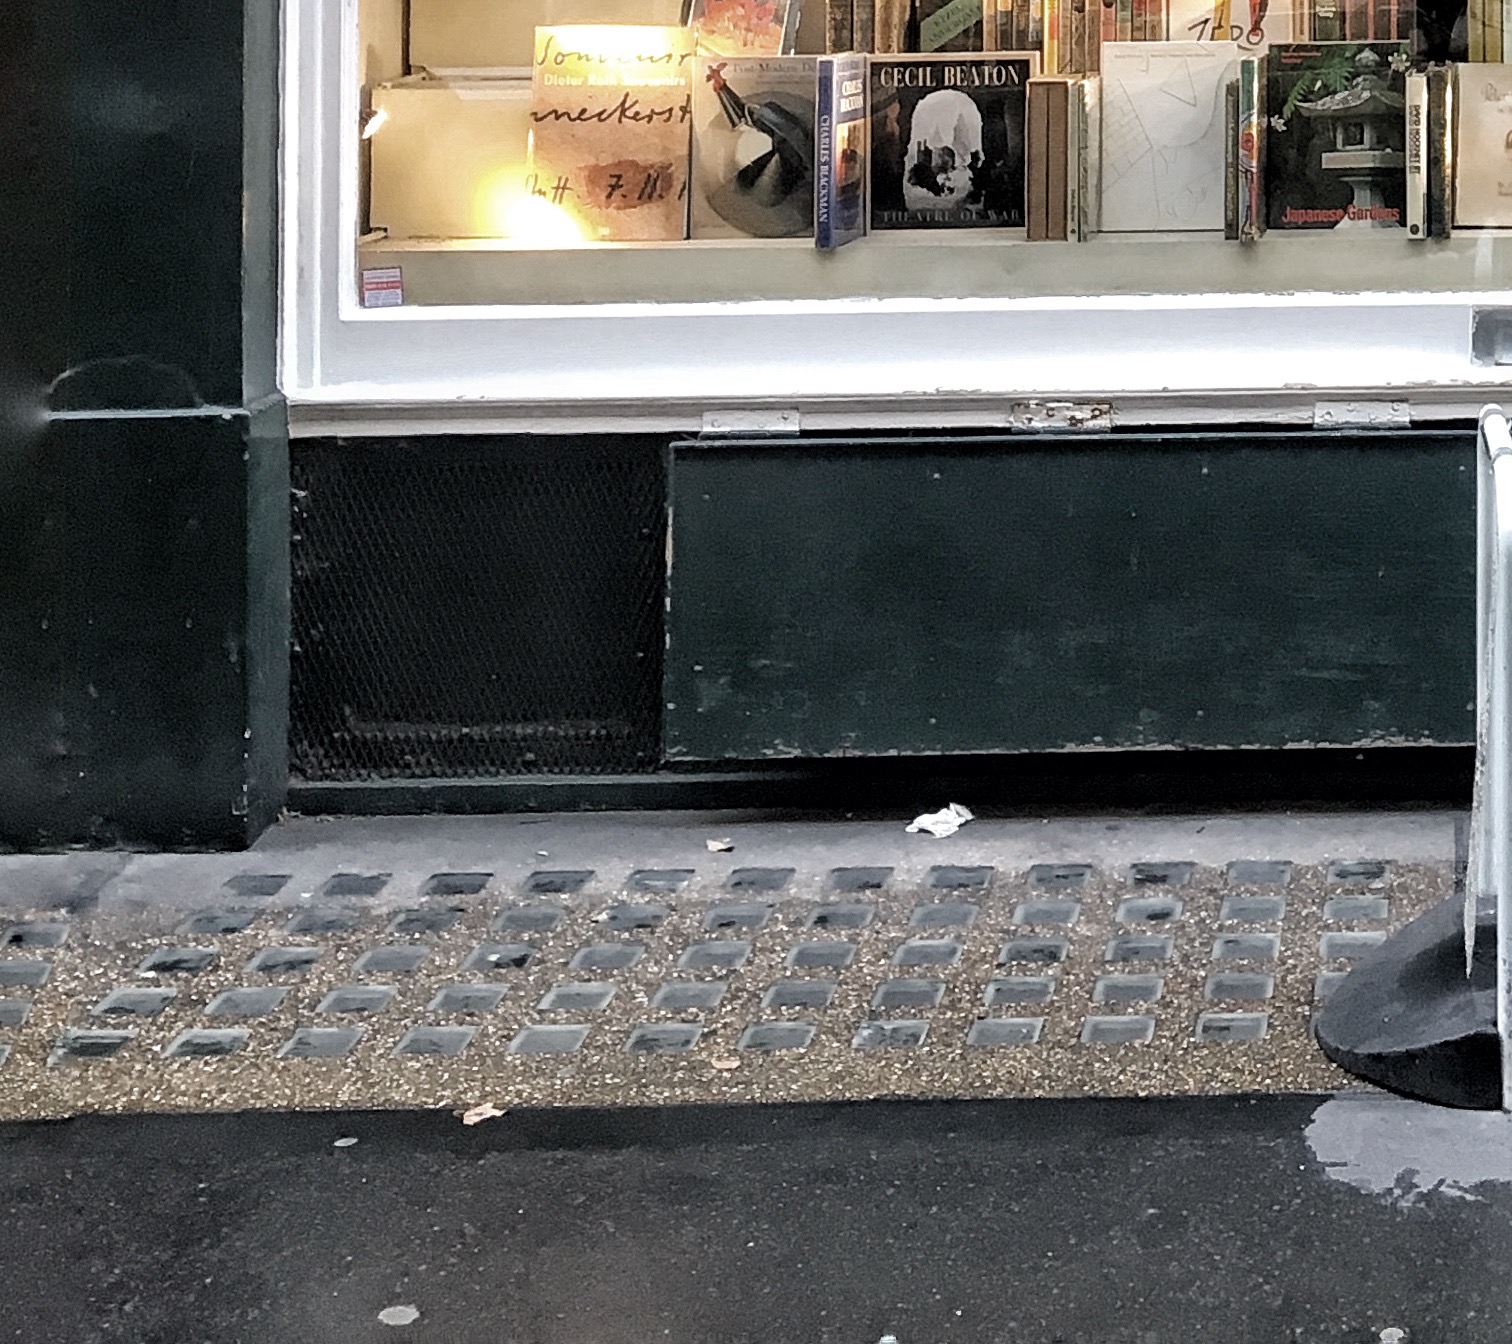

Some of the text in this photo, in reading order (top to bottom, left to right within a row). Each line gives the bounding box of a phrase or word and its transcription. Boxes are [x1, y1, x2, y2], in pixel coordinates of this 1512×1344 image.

[544, 73, 584, 86] Dieter
[880, 65, 1020, 88] CECIL BEATON
[818, 114, 830, 224] CHARLES BLACKMAN
[882, 208, 1020, 223] THEATRE OF WAR
[1281, 203, 1400, 224] Japanese Gardens
